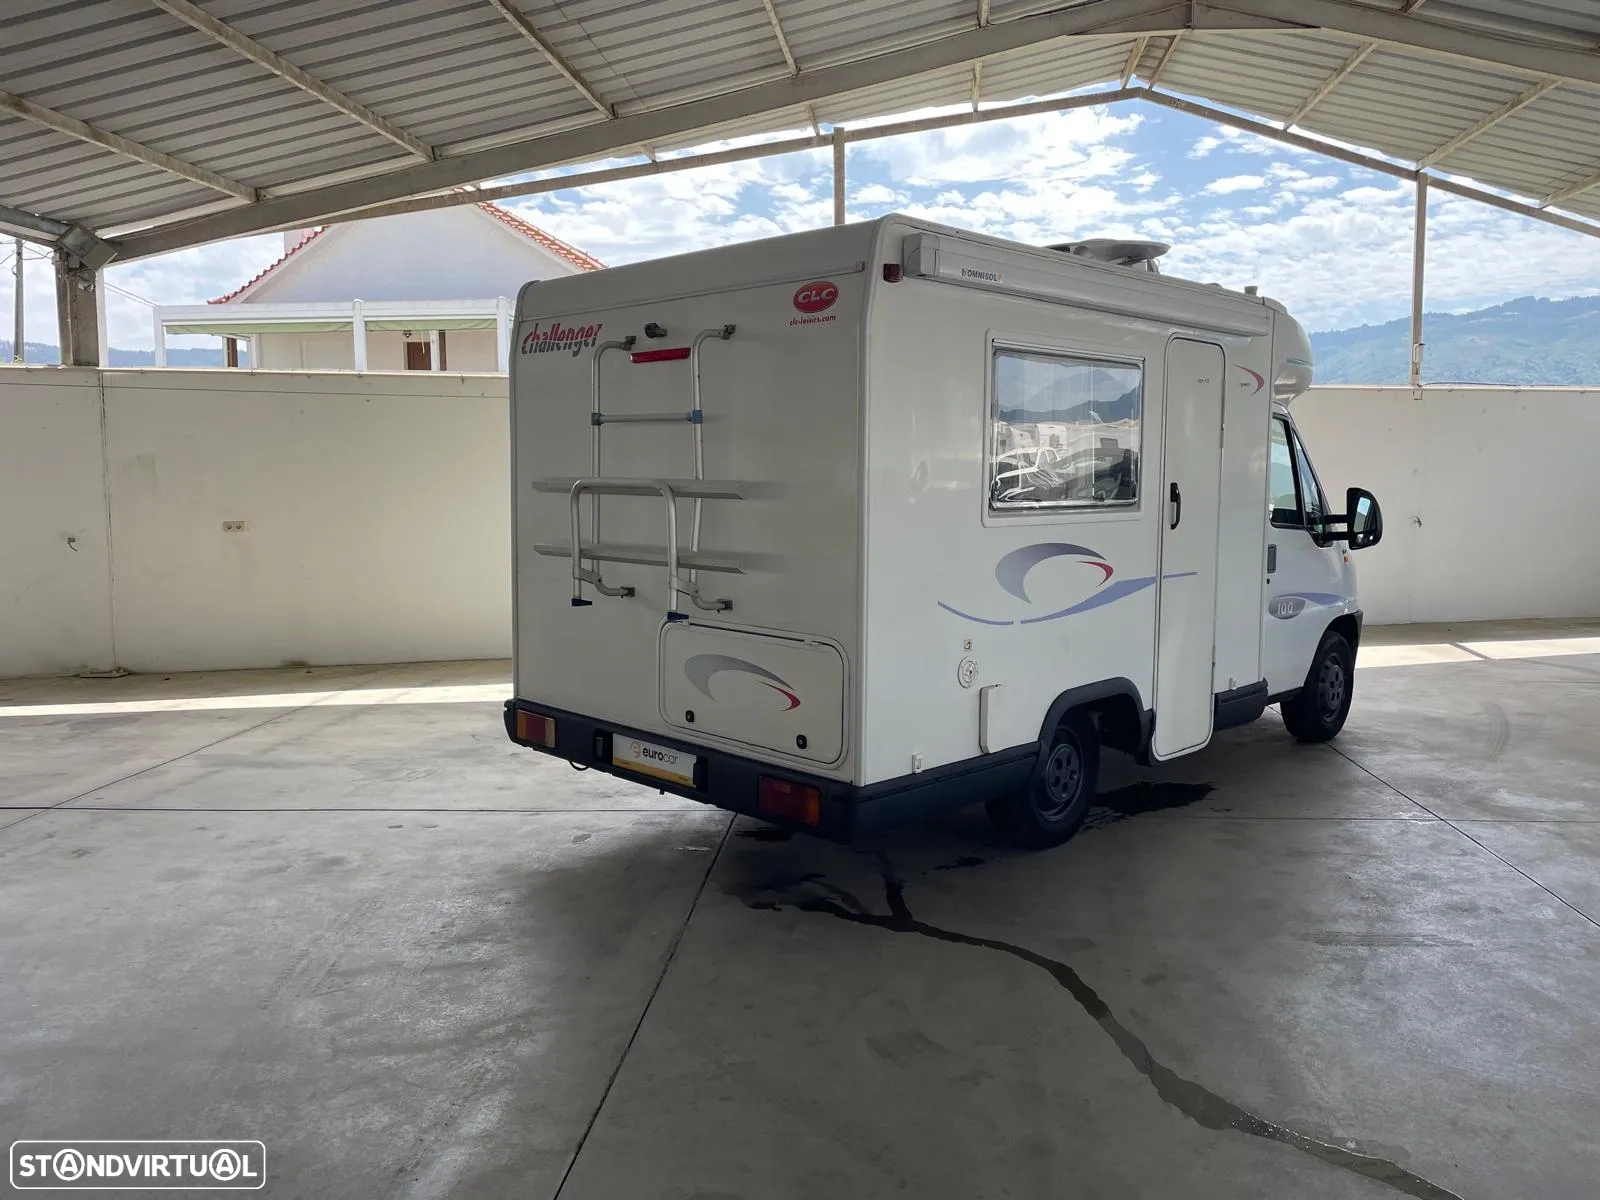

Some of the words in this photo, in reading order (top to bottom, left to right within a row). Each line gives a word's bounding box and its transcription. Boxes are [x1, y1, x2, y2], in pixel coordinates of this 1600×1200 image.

[797, 288, 835, 303] CLC
[789, 315, 836, 327] clc-loisirs.com
[1277, 601, 1294, 615] 100
[642, 747, 679, 765] eurocar
